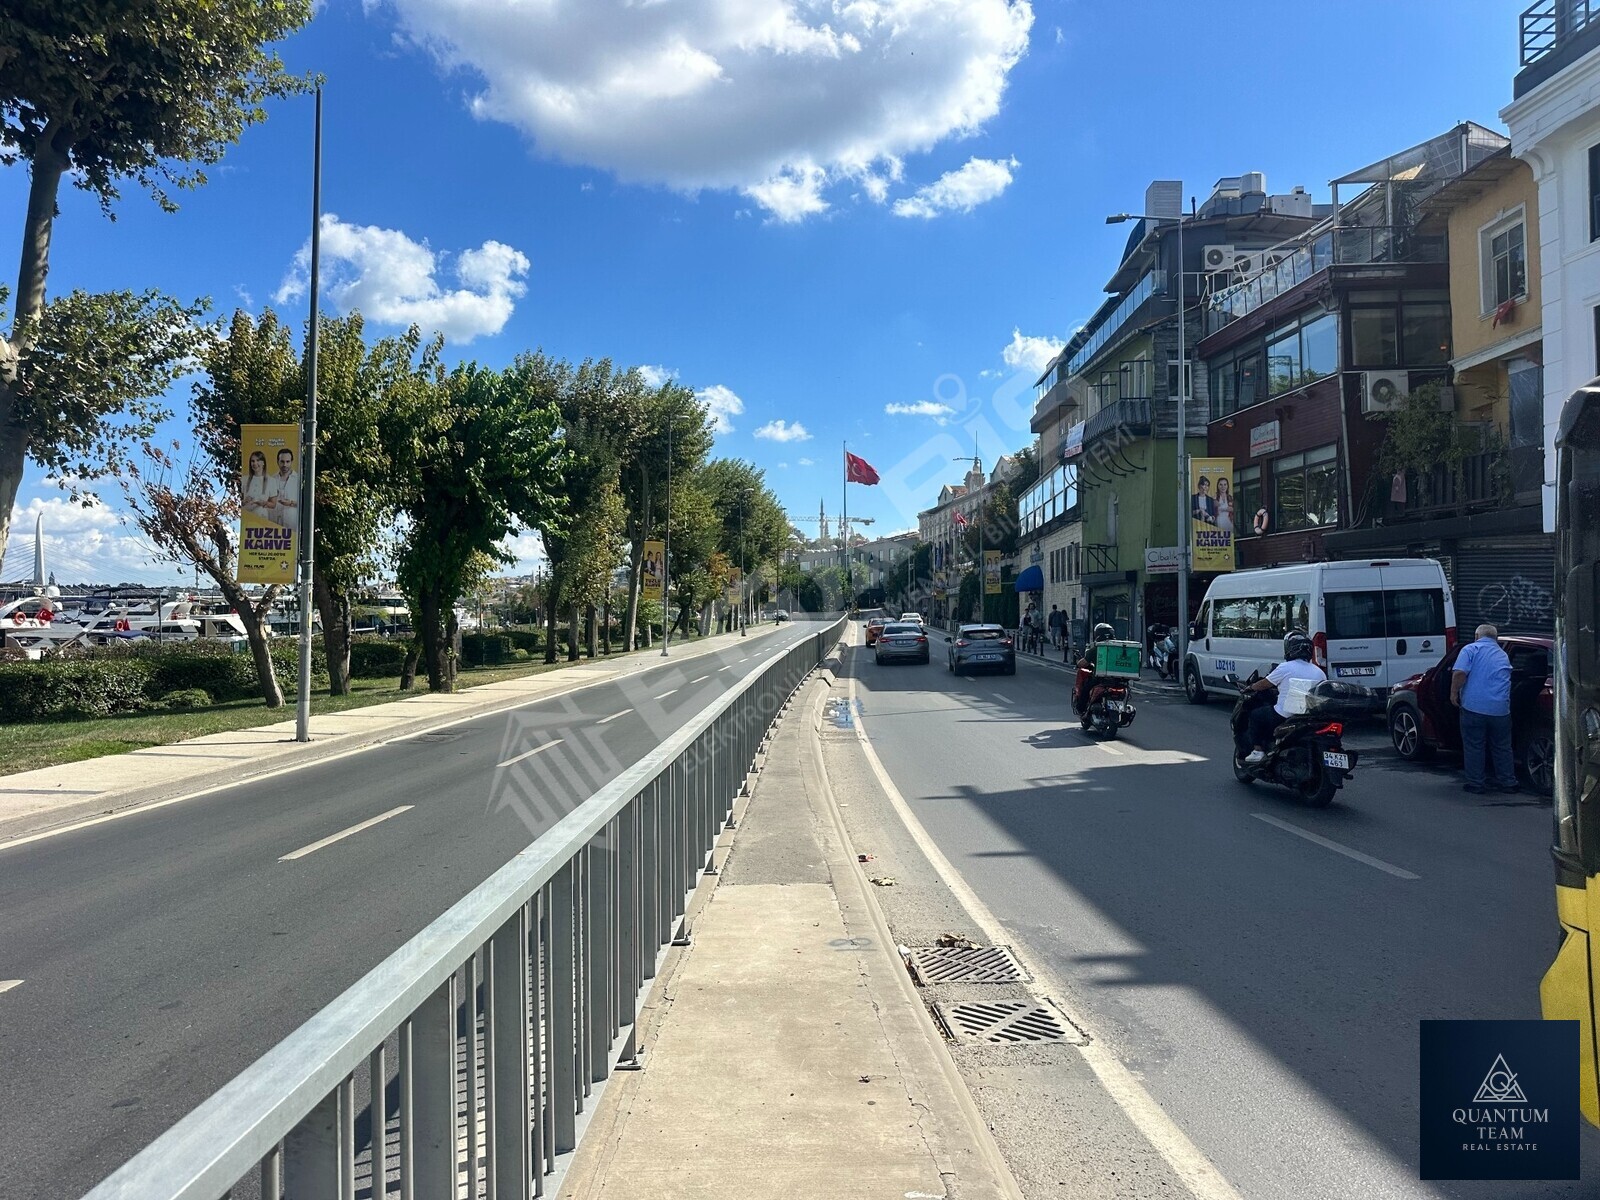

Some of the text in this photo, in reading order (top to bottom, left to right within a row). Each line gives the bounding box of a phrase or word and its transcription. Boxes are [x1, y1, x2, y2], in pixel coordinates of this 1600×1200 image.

[245, 528, 292, 539] TUZLU
[244, 540, 292, 550] KAHVE
[1196, 539, 1231, 547] KAHVE
[1215, 659, 1236, 671] LDZ118
